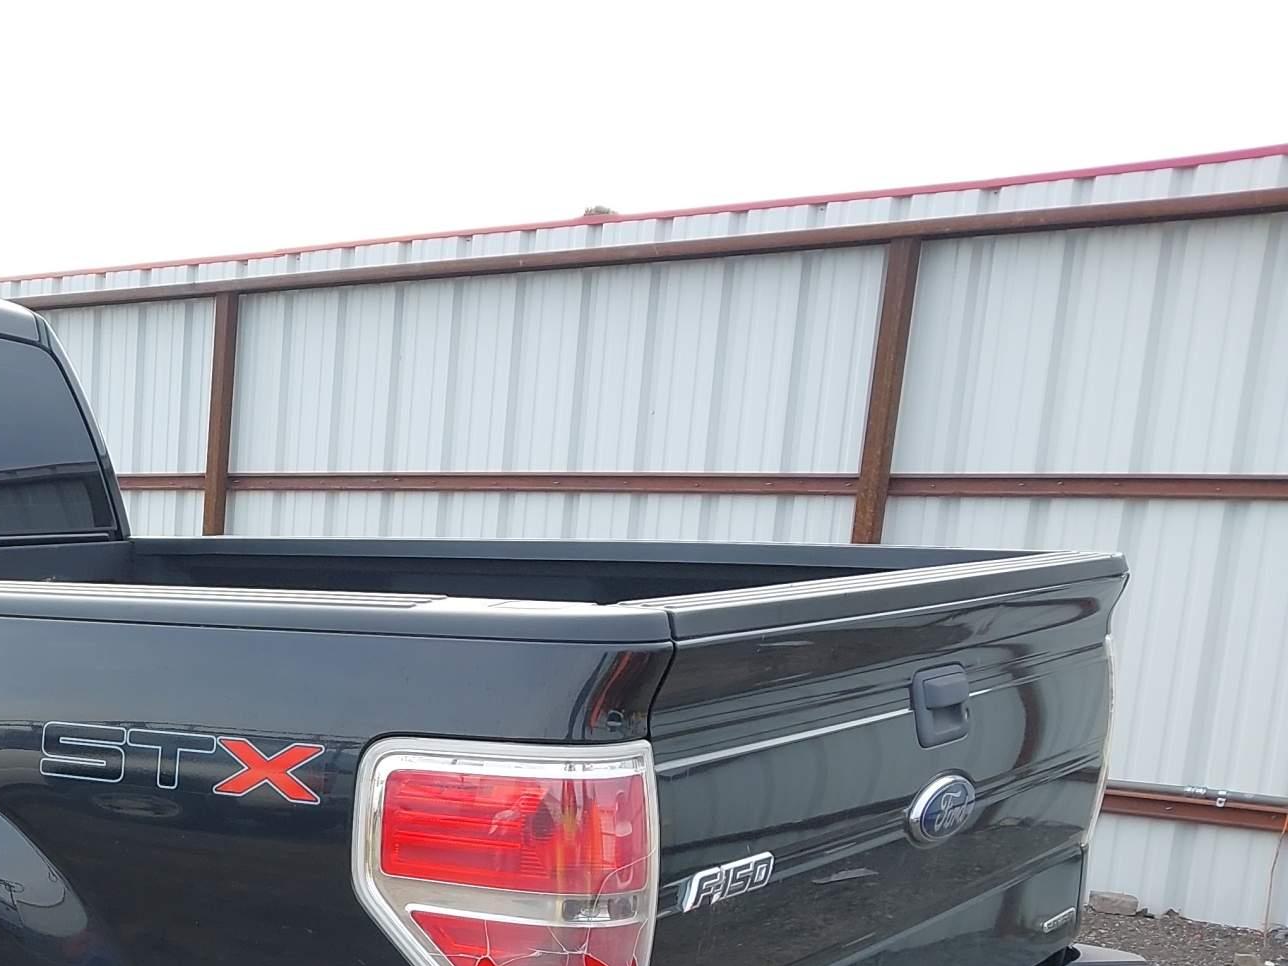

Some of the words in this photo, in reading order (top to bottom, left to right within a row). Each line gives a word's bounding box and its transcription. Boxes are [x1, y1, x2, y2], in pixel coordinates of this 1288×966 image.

[39, 720, 326, 805] STX
[933, 789, 969, 832] Ford
[682, 850, 775, 913] F-150
